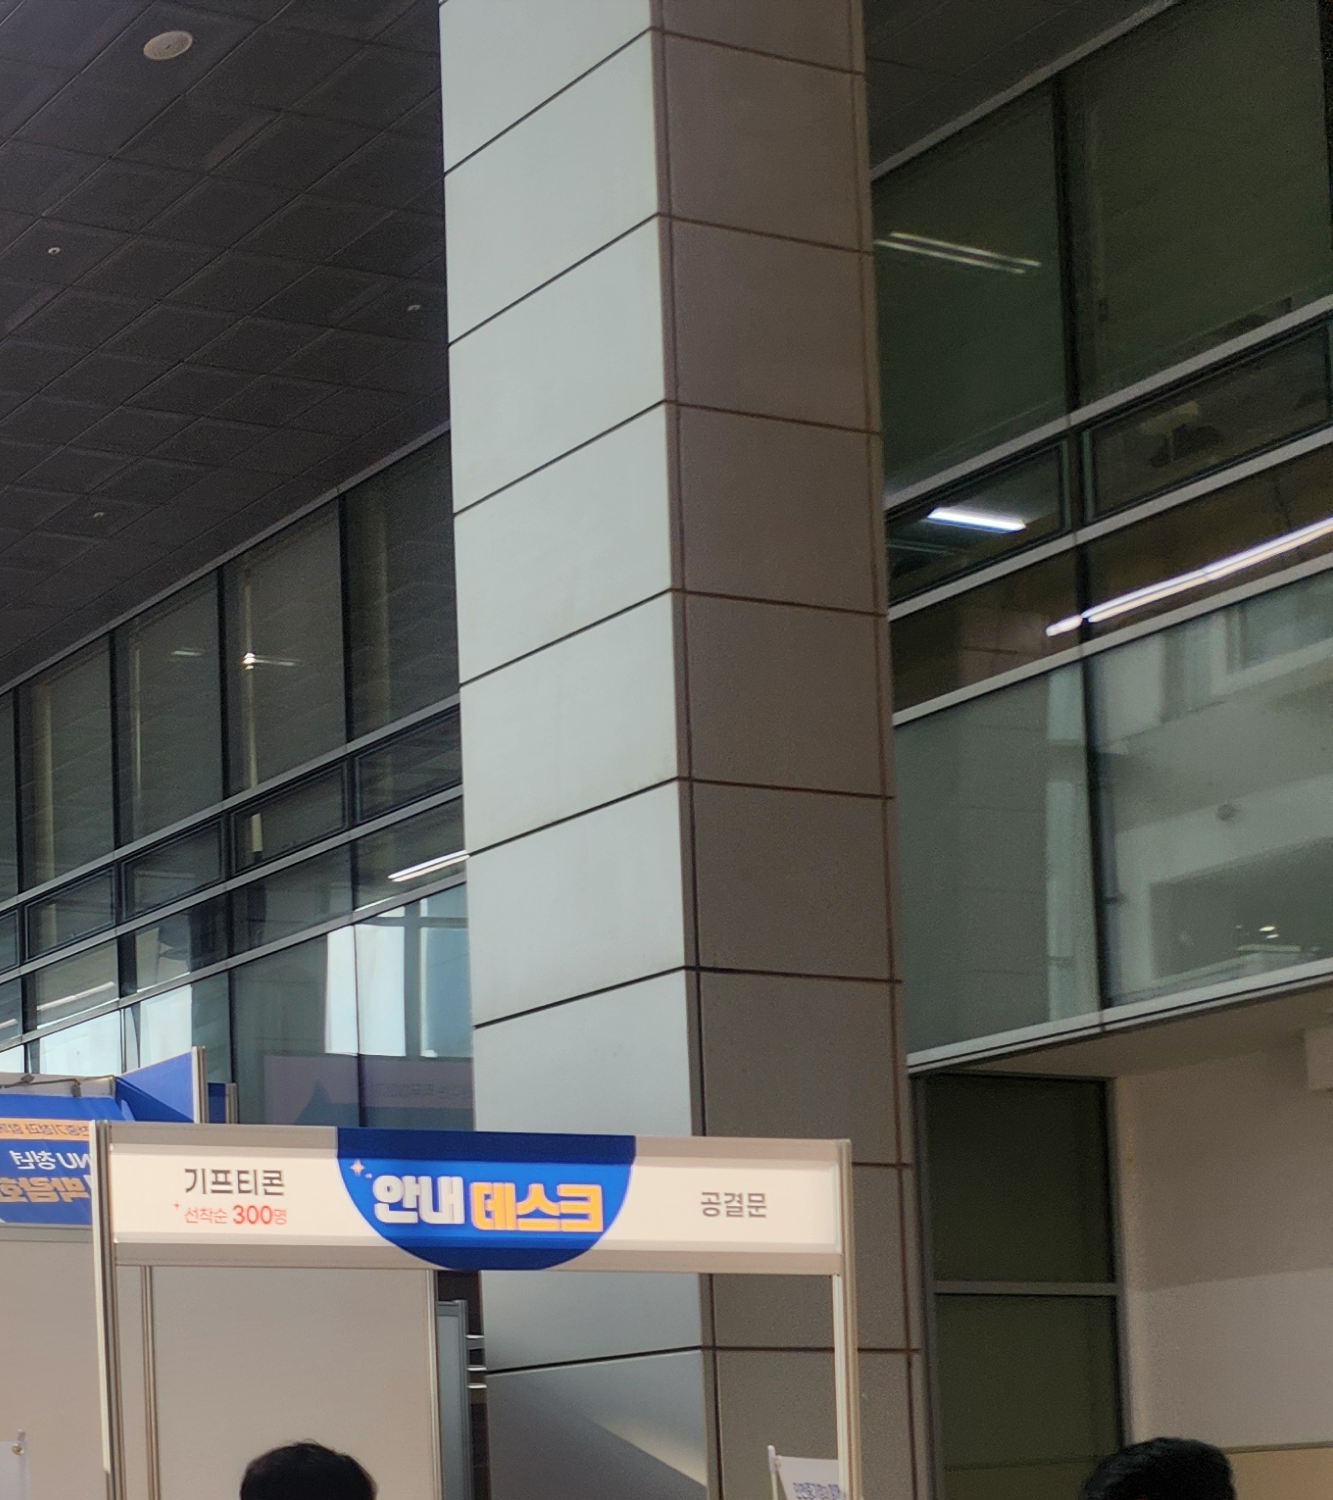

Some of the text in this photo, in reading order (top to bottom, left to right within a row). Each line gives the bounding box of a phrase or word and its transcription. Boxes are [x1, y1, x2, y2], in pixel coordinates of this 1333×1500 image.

[185, 1168, 285, 1196] 기프티콘
[185, 1205, 287, 1225] 선착순 300명
[372, 1174, 604, 1232] 안내 데스크
[701, 1191, 767, 1218] 공결문
